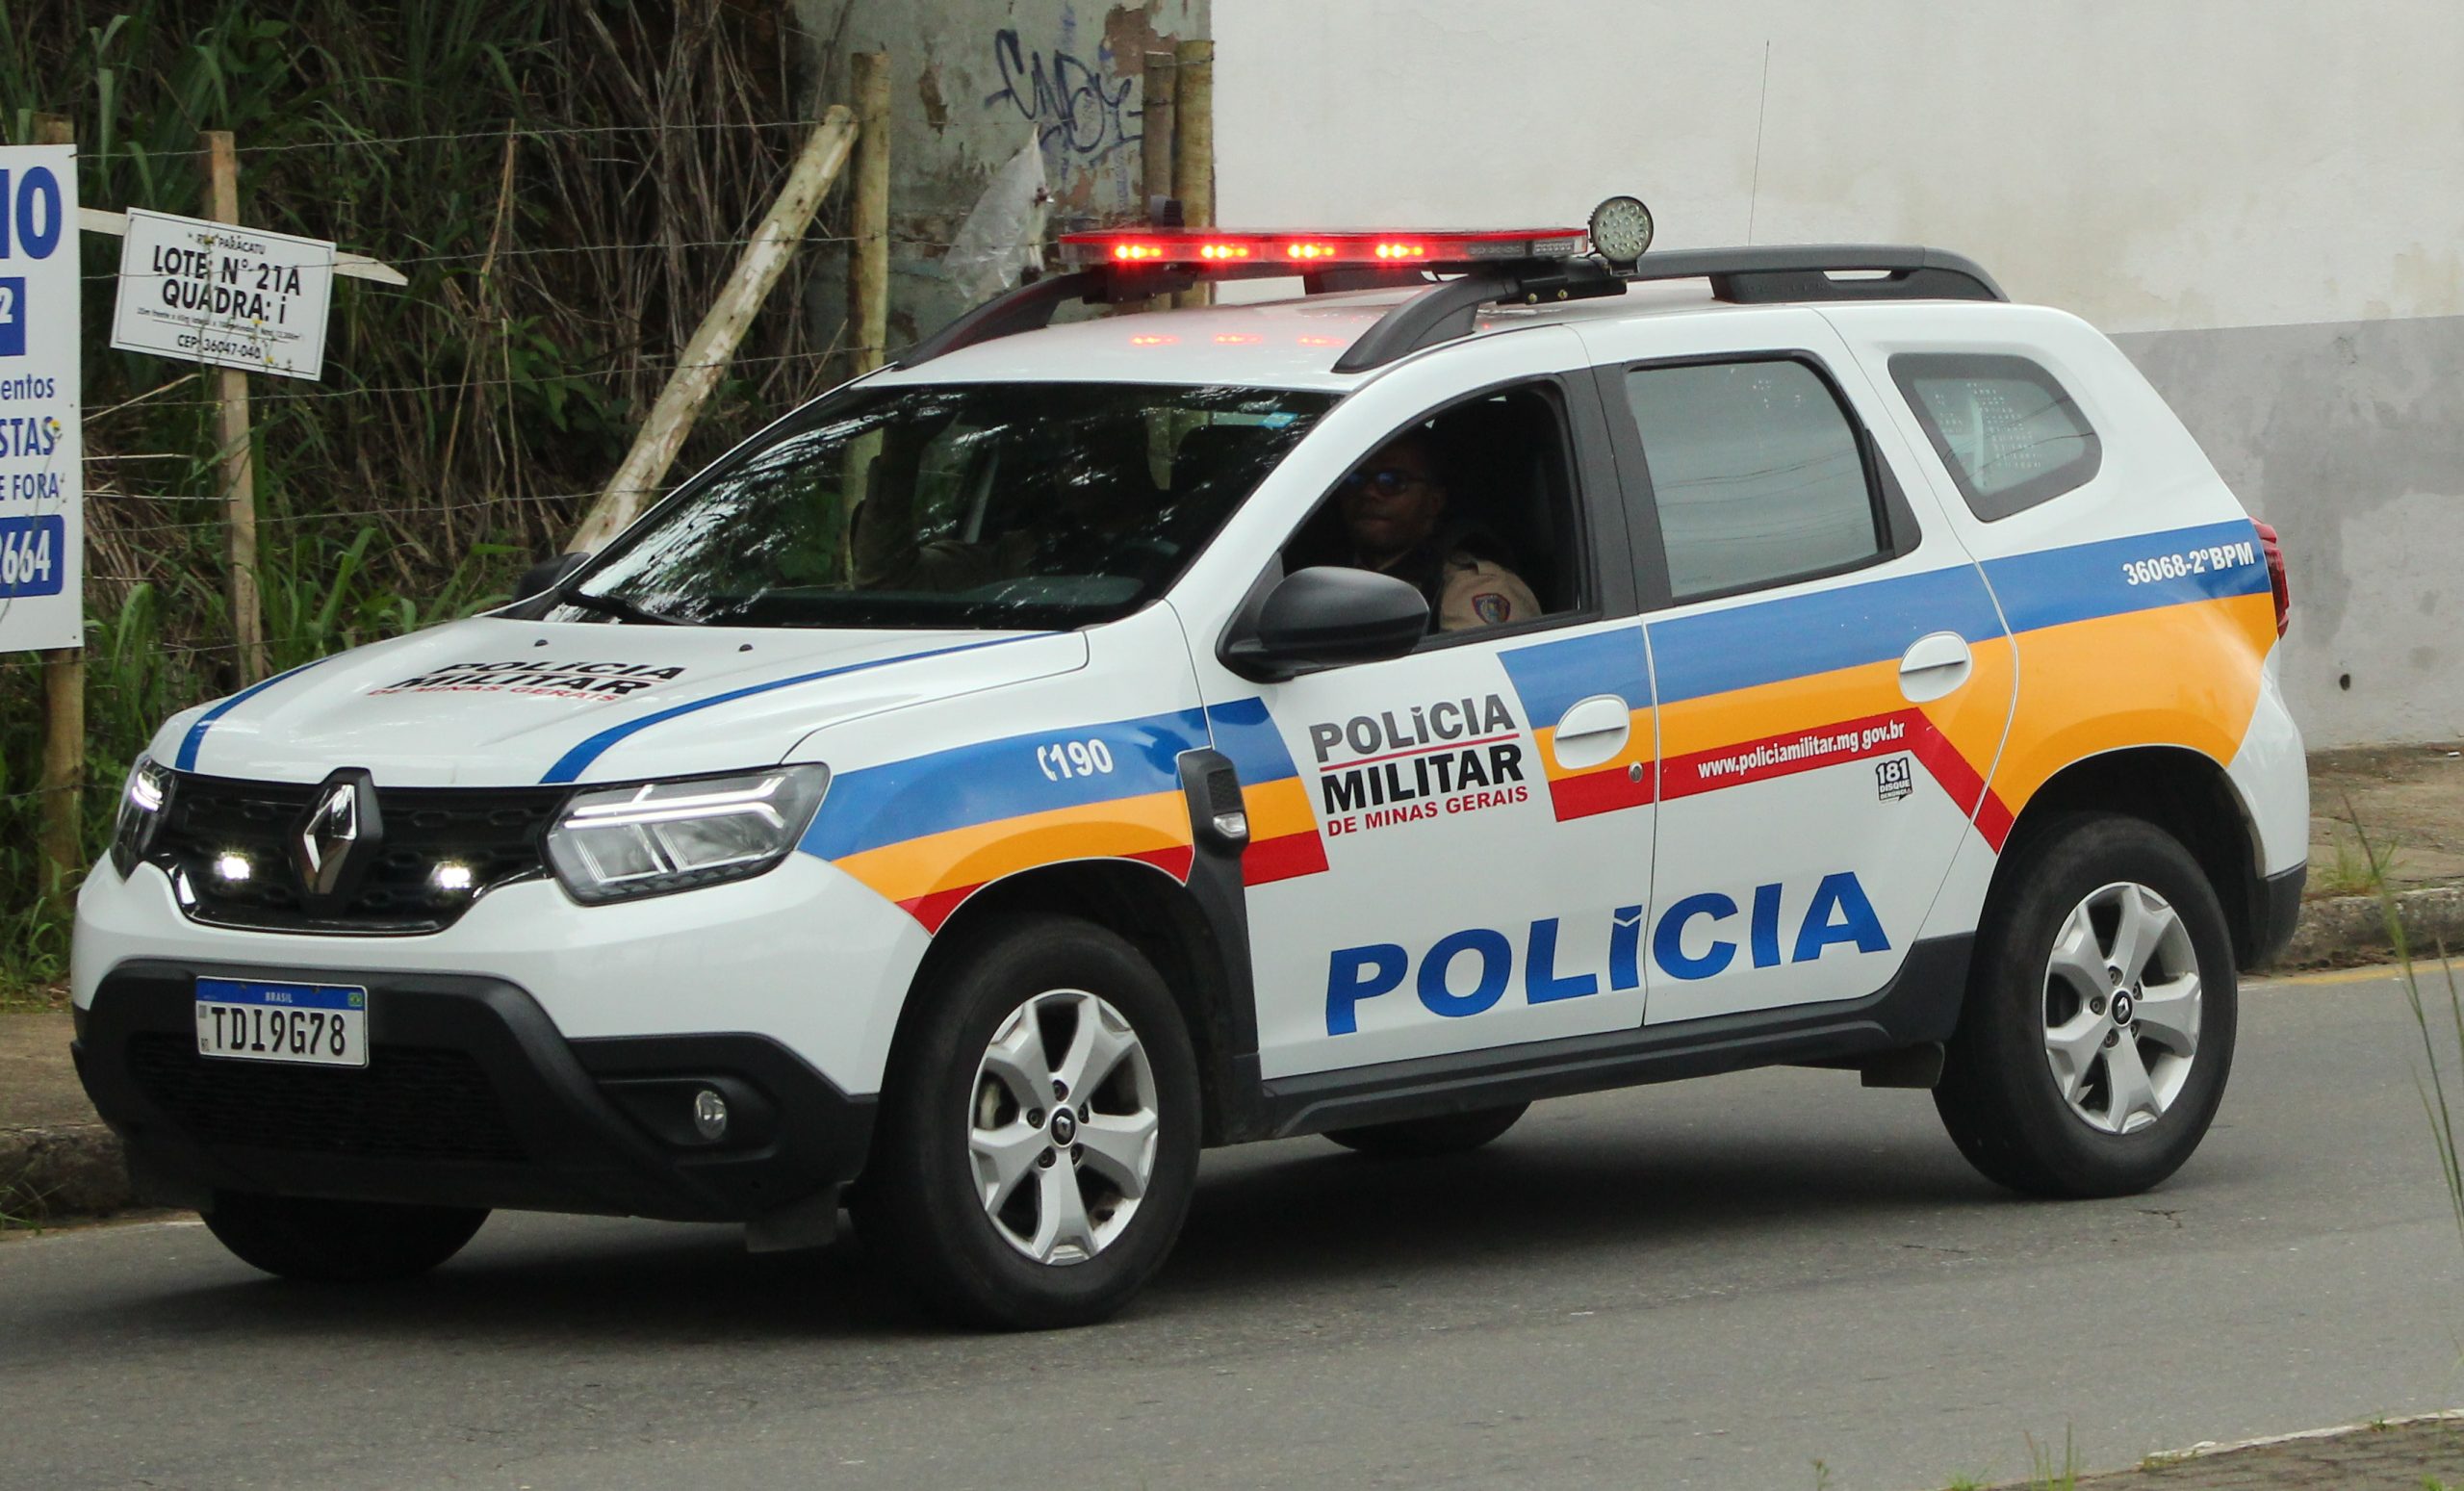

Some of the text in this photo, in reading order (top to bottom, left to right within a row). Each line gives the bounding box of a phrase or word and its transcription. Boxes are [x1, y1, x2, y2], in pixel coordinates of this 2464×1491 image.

[256, 263, 301, 297] 21A
[162, 278, 270, 321] QUADRA:
[13, 473, 59, 501] FORA
[385, 674, 655, 695] MILITAR
[411, 684, 502, 694] MINAS
[510, 686, 619, 702] GERAIS
[1049, 738, 1114, 779] 190
[1876, 758, 1910, 784] 181
[1321, 743, 1525, 814] MILITAR
[1880, 780, 1911, 793] DISQUE
[1327, 785, 1528, 836] DE MINAS GERAIS
[264, 990, 294, 1004] BRASIL
[211, 1007, 346, 1056] TDI9G78
